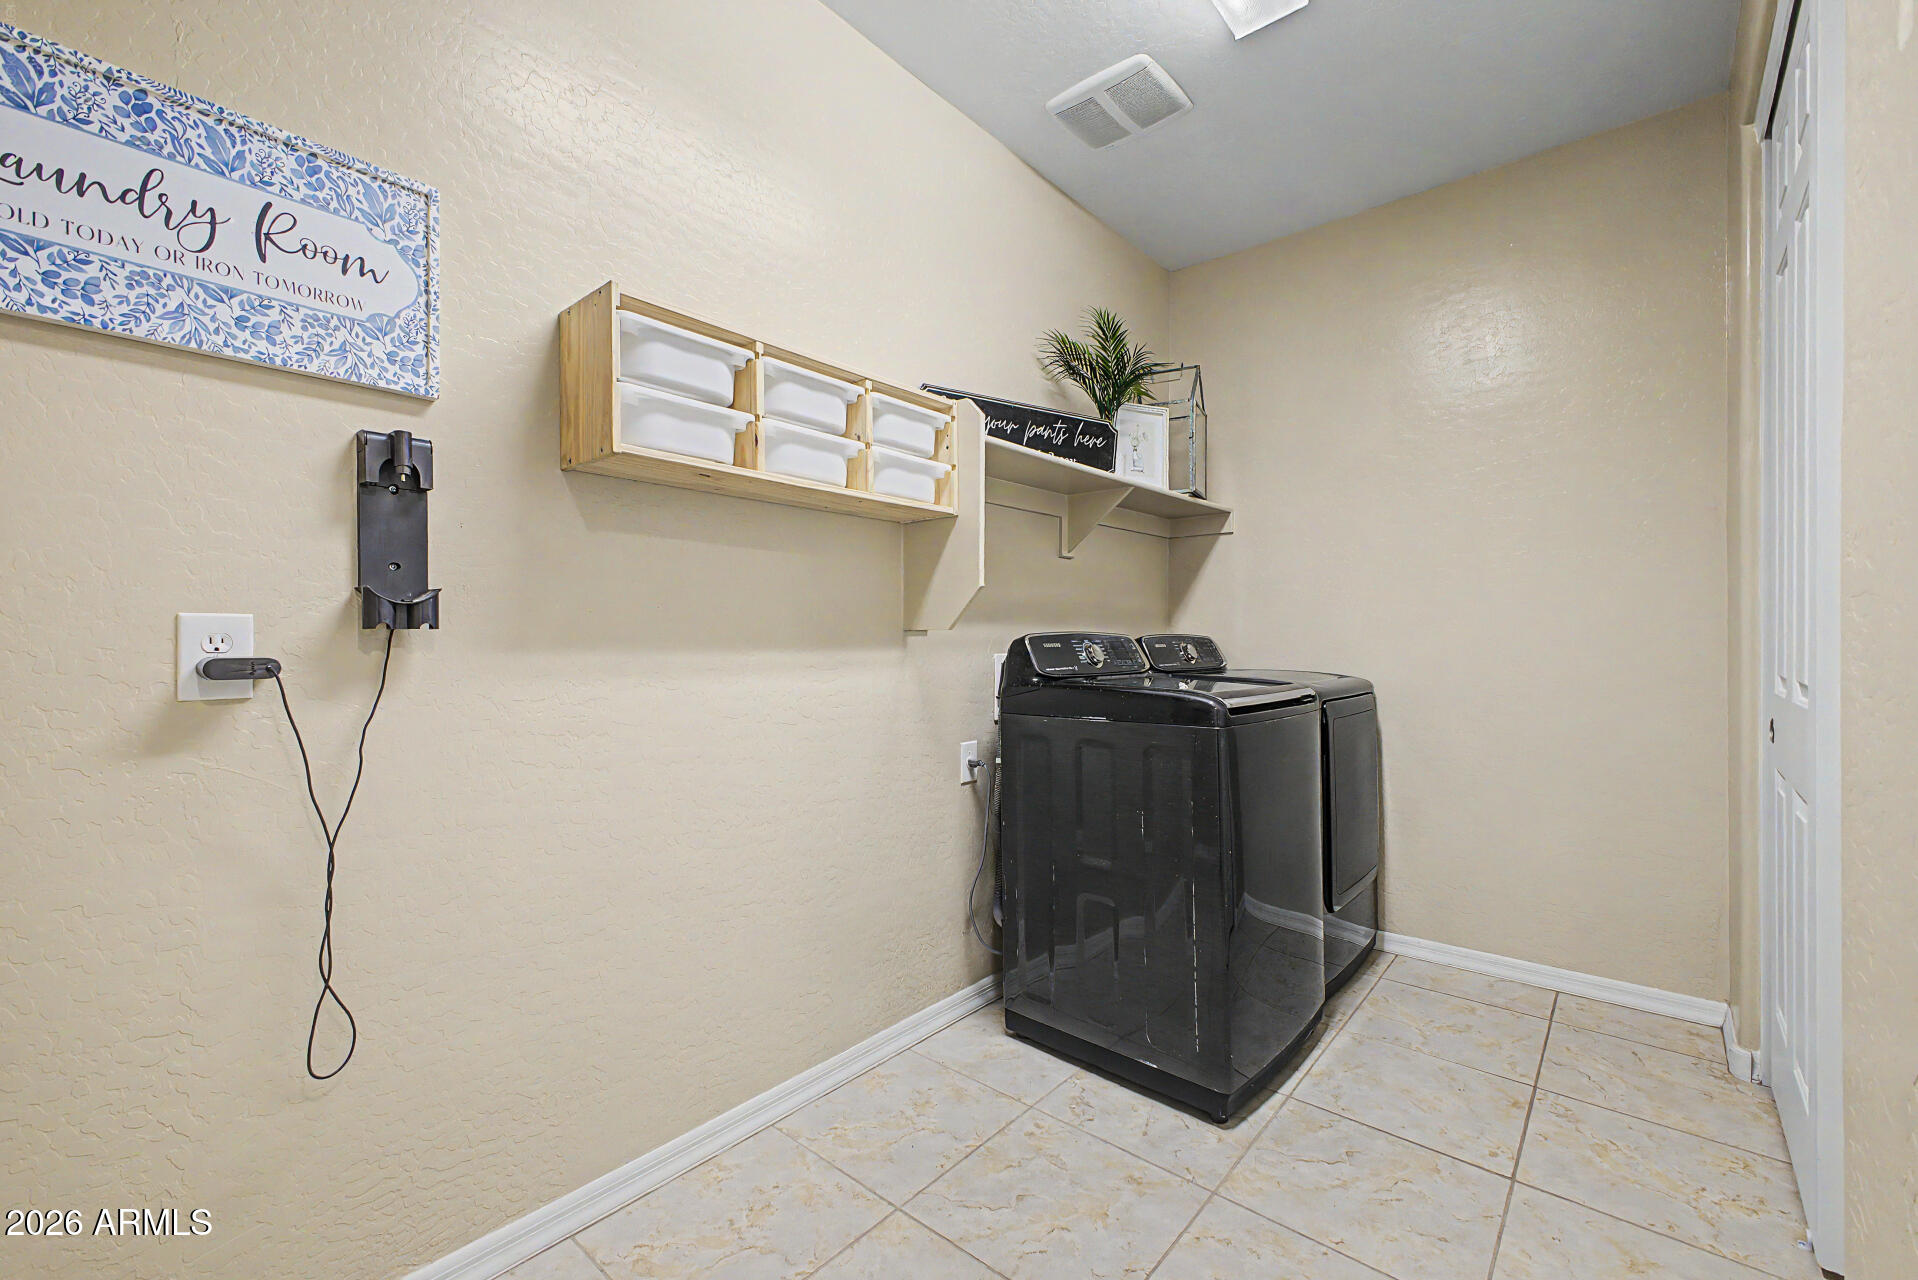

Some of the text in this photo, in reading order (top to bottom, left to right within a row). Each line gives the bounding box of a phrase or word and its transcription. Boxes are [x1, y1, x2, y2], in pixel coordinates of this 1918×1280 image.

[0, 153, 389, 284] aundry Room
[0, 202, 364, 312] OLD TODAY OR IRON TOMORROW
[1023, 420, 1069, 446] pants
[1073, 421, 1107, 448] here
